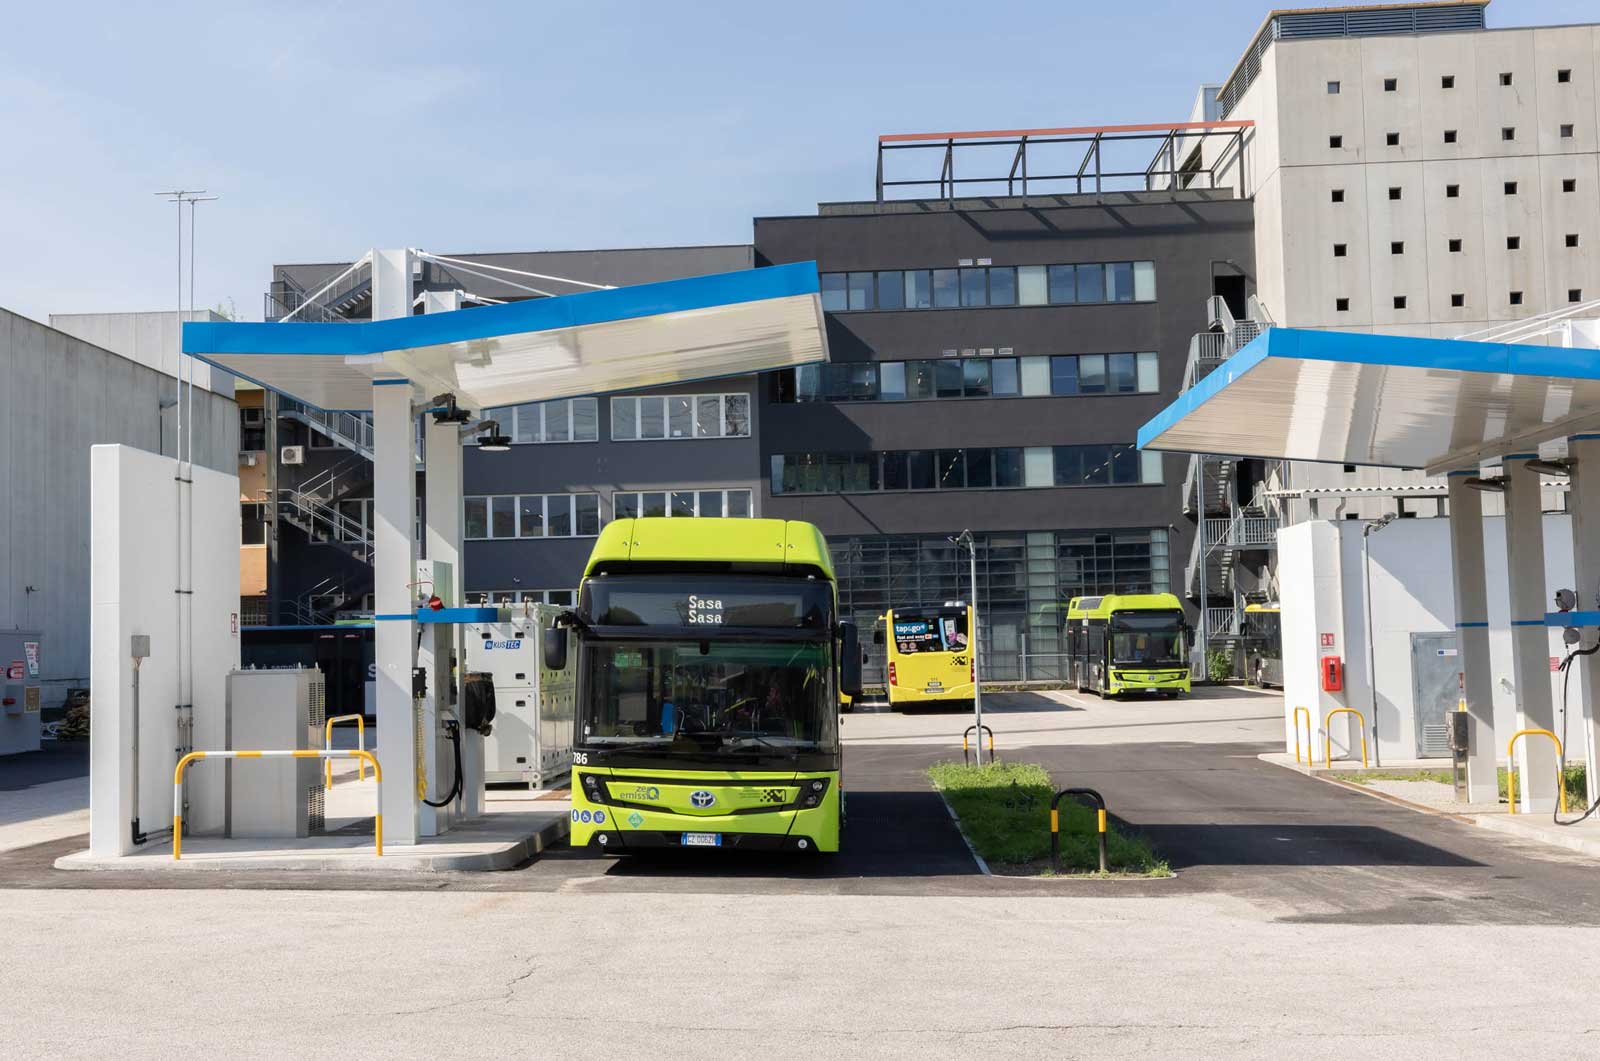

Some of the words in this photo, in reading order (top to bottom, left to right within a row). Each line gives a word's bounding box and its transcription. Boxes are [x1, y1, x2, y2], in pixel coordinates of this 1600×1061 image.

[688, 595, 723, 609] Sasa
[688, 609, 723, 624] Sasa
[572, 752, 588, 765] 786
